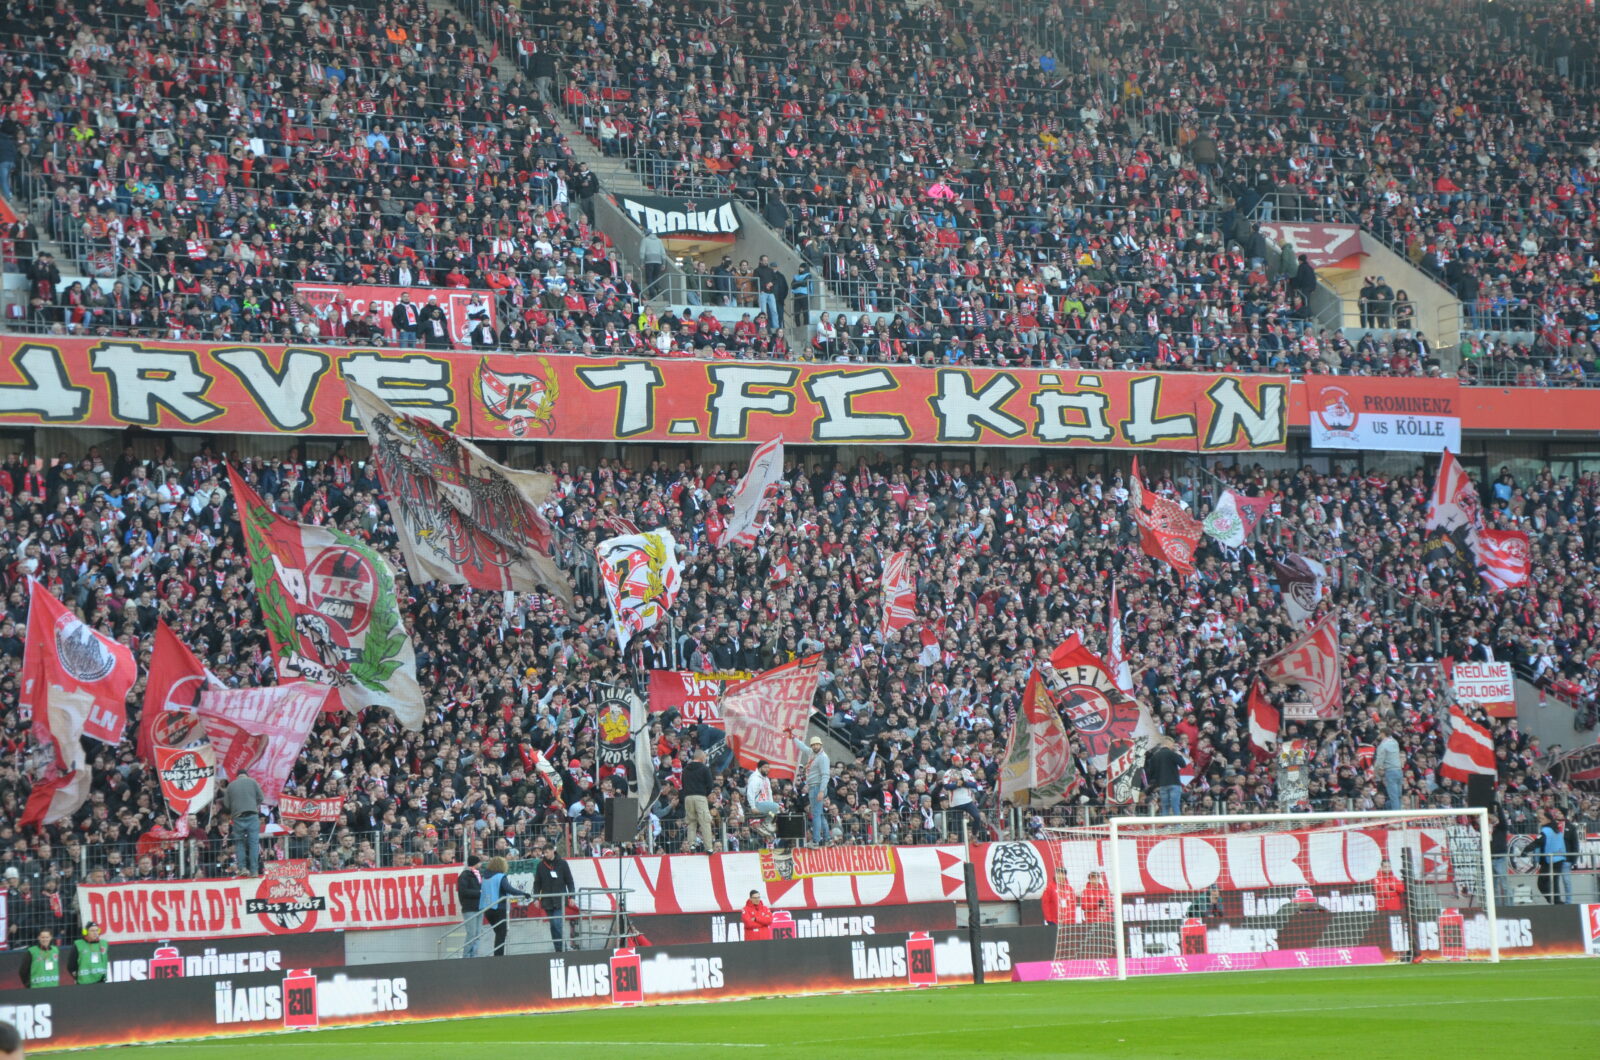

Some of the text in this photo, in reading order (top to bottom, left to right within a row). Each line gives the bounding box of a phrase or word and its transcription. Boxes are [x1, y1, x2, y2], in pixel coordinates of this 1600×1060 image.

[624, 198, 740, 234] TROIKA
[506, 383, 531, 409] 12
[577, 360, 1287, 447] 1.FC KÖLN
[1363, 395, 1452, 414] PROMINENZ
[1372, 415, 1445, 437] US KÖLLE
[320, 577, 364, 600] 1.FC
[319, 598, 355, 620] KÖLN
[1455, 664, 1508, 678] REDLINE
[1458, 684, 1511, 698] COLOGNE
[791, 844, 891, 875] STADIONVERBOT
[88, 873, 459, 937] DOMSTADT SYNDIKAT
[286, 899, 321, 911] 2007
[1318, 890, 1377, 913] DÖNER
[851, 945, 907, 980] HAUS
[216, 980, 232, 990] DAS
[550, 963, 611, 999] HAUS
[215, 985, 282, 1024] HAUS
